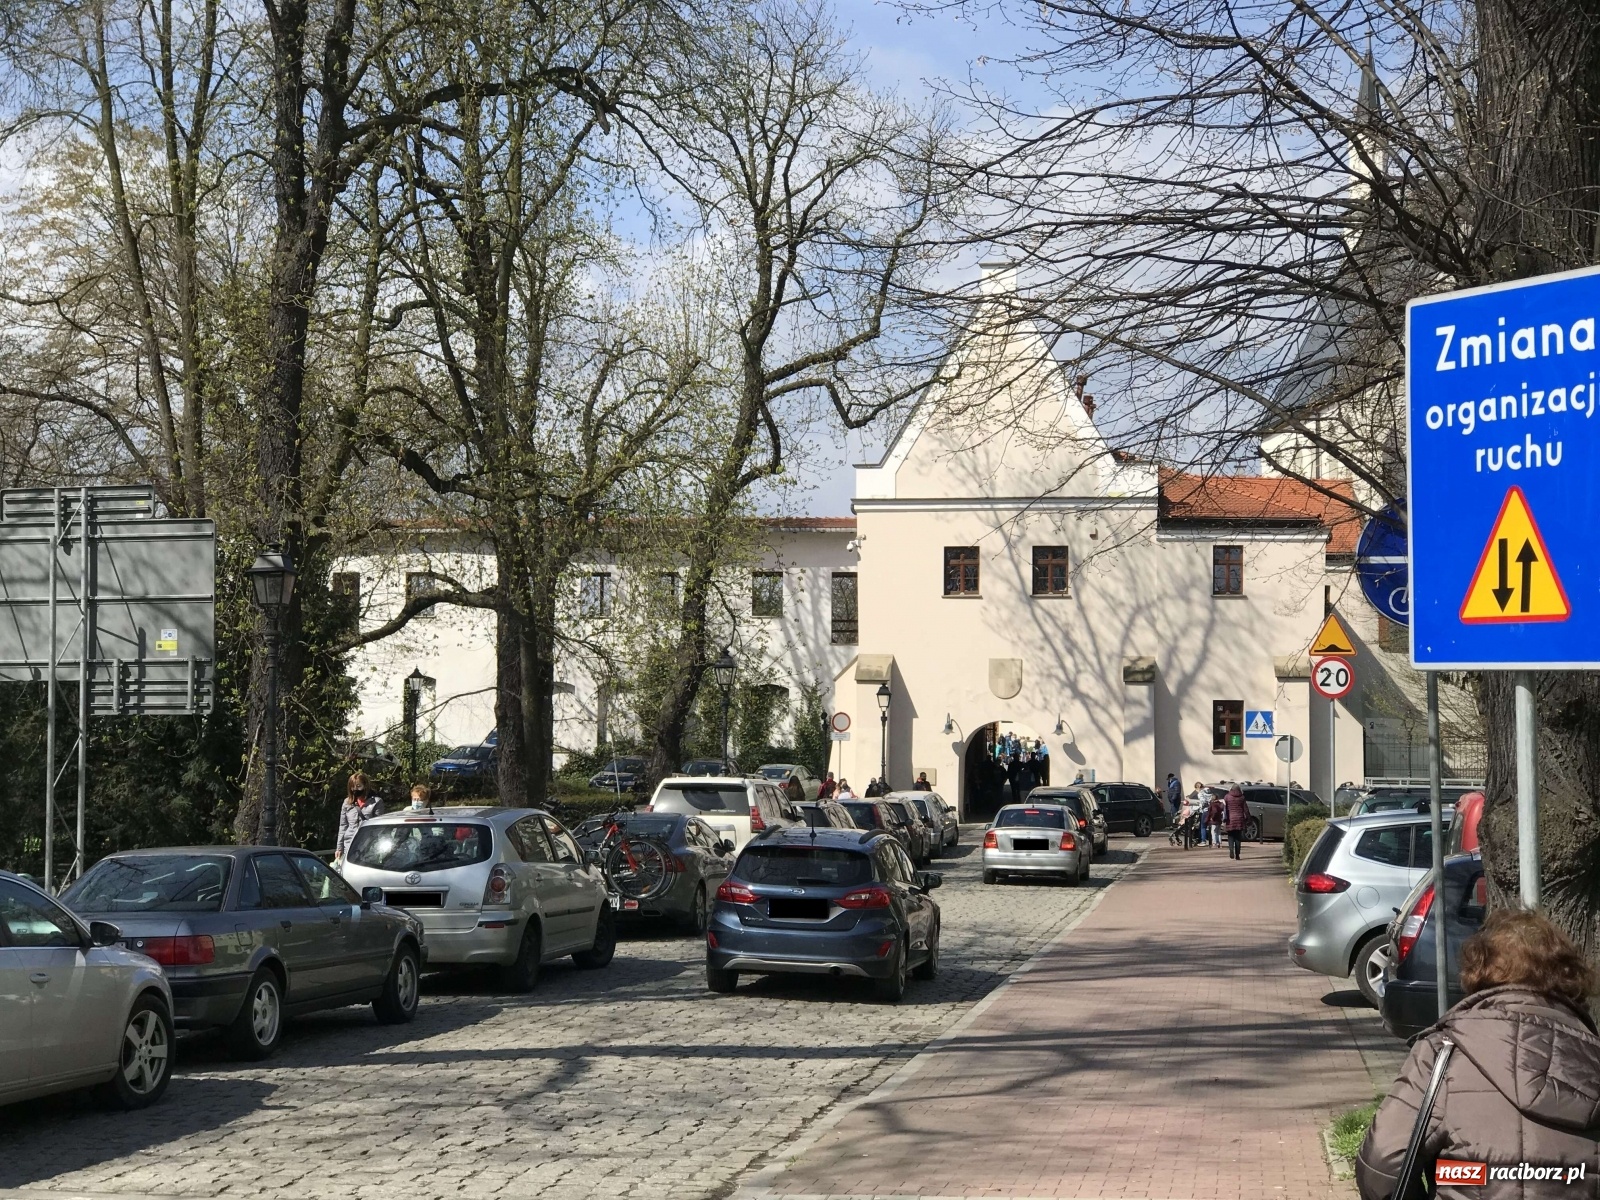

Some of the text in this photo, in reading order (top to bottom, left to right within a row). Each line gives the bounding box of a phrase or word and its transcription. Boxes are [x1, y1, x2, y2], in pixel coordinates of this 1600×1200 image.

[1434, 316, 1596, 372] Zmiana
[1425, 371, 1600, 436] organizacj
[1475, 433, 1563, 473] ruchu
[1319, 667, 1349, 688] 20
